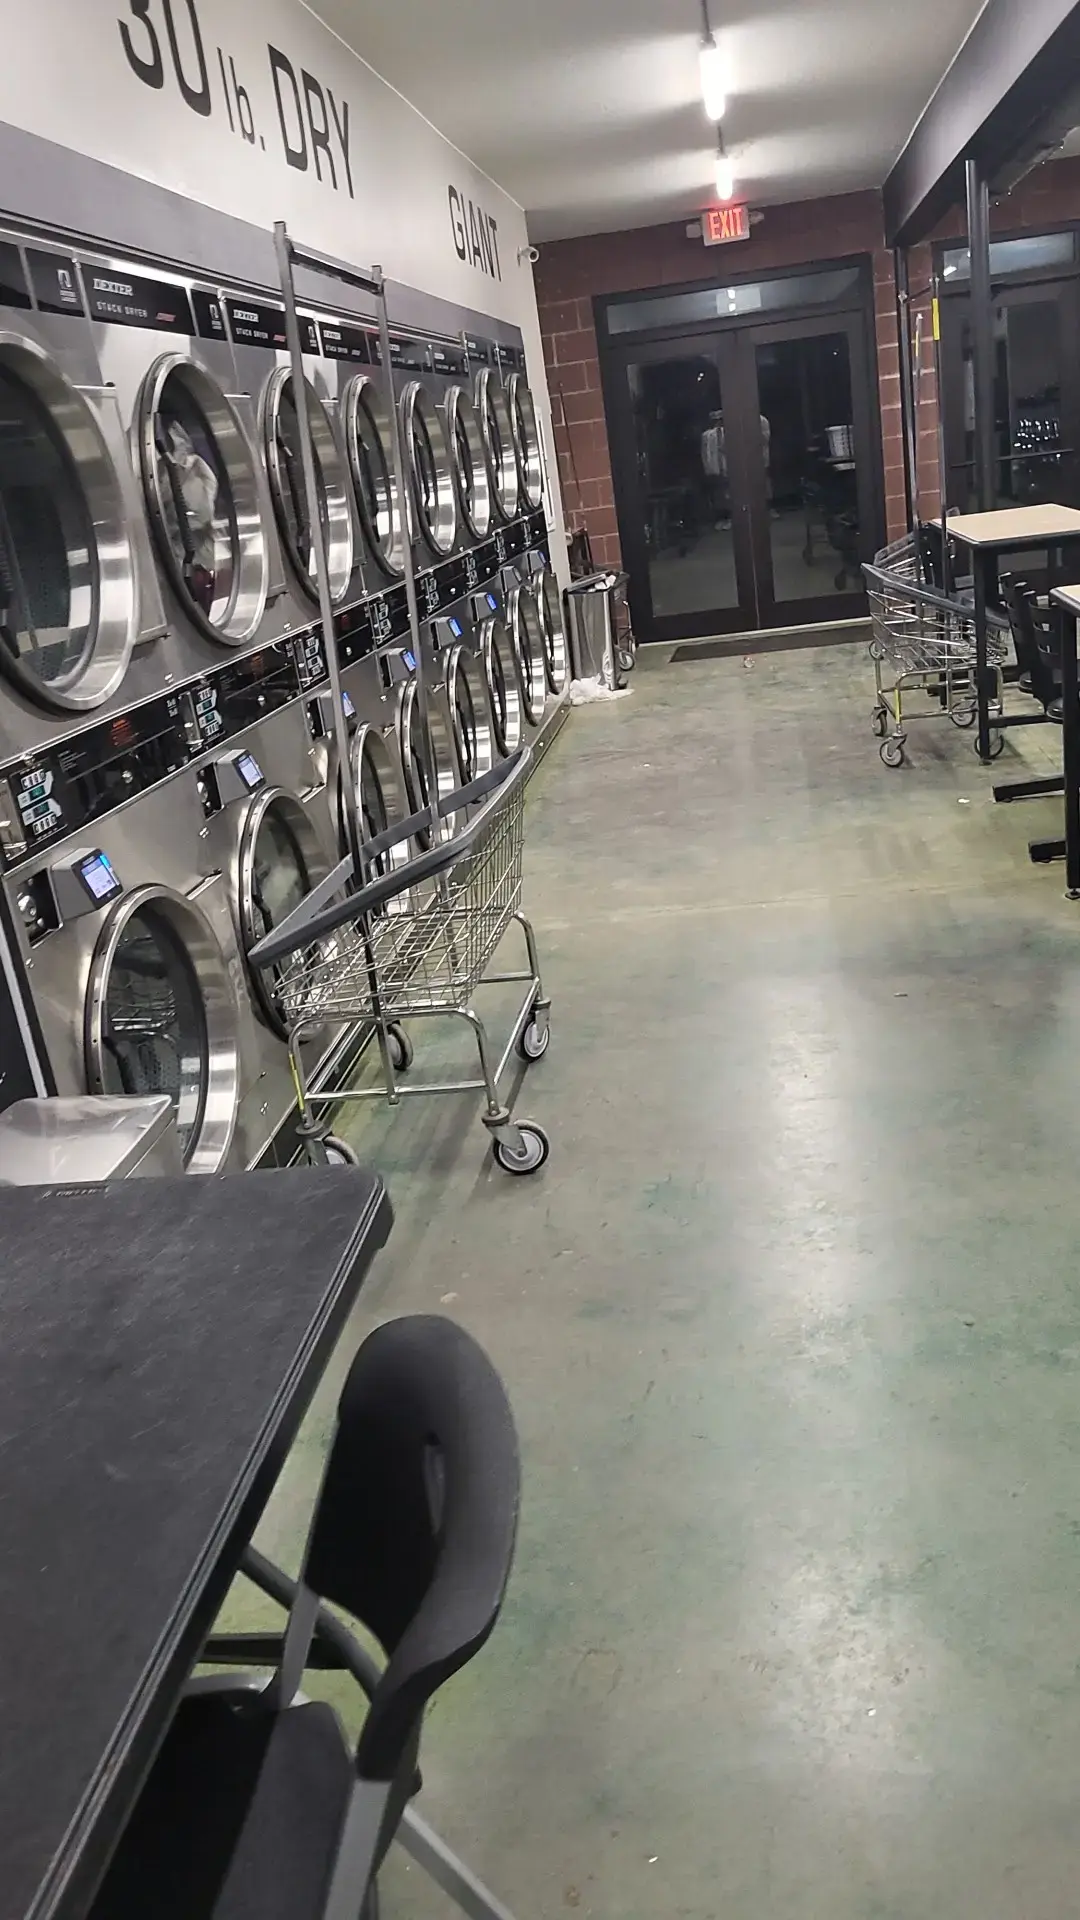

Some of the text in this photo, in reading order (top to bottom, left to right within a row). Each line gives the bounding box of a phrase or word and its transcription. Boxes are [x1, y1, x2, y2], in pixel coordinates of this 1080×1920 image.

[117, 0, 354, 199] 30 lb. DRY
[448, 185, 501, 282] GIANT
[709, 208, 744, 240] EXIT
[93, 278, 134, 296] DEXTER
